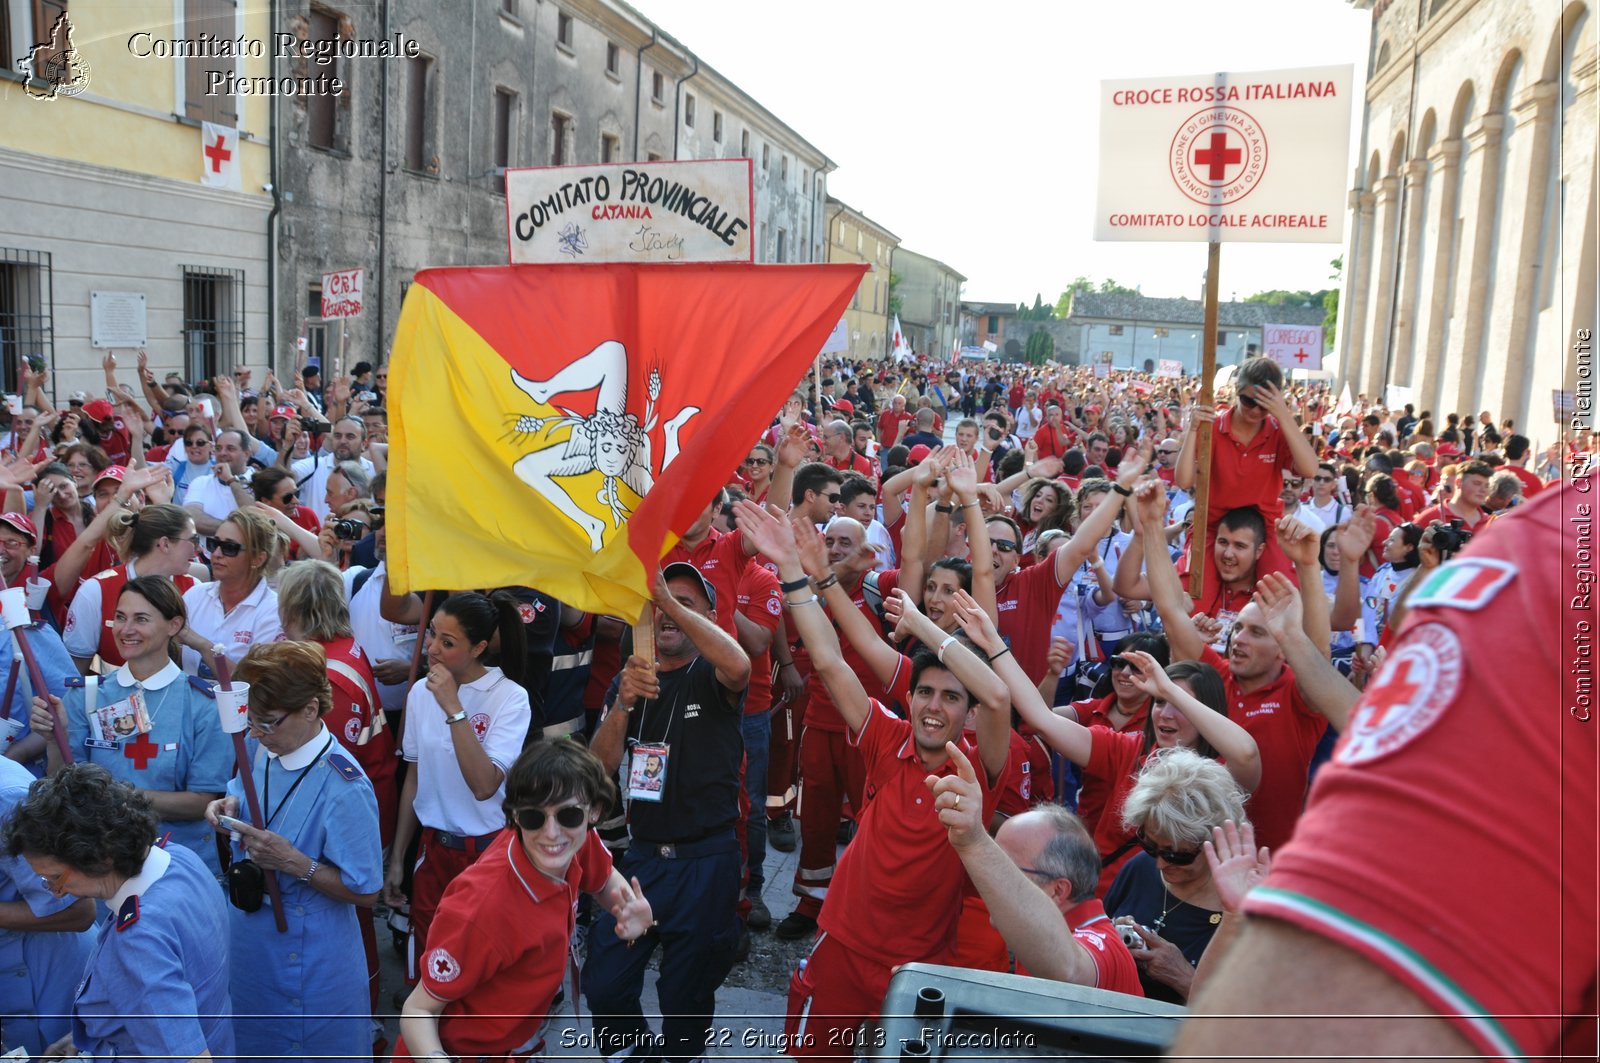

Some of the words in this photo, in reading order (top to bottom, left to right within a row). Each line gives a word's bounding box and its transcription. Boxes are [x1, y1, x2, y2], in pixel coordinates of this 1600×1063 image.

[1113, 89, 1172, 105] CROCE
[1178, 86, 1240, 103] ROSSA
[1245, 80, 1337, 100] ITALIANA
[1199, 112, 1245, 127] GINEVRA
[1187, 123, 1198, 134] DI
[1245, 125, 1256, 136] 22
[1176, 135, 1209, 198] CONVENZIONE
[1244, 139, 1262, 183] AGOSTO
[1222, 183, 1244, 198] 1864
[515, 174, 610, 242] COMITATO
[619, 168, 748, 246] PROVINCIALE
[591, 204, 653, 221] CATANIA
[1109, 214, 1184, 227] COMITATO
[1188, 214, 1247, 227] LOCALE
[1251, 214, 1328, 228] ACIREALE
